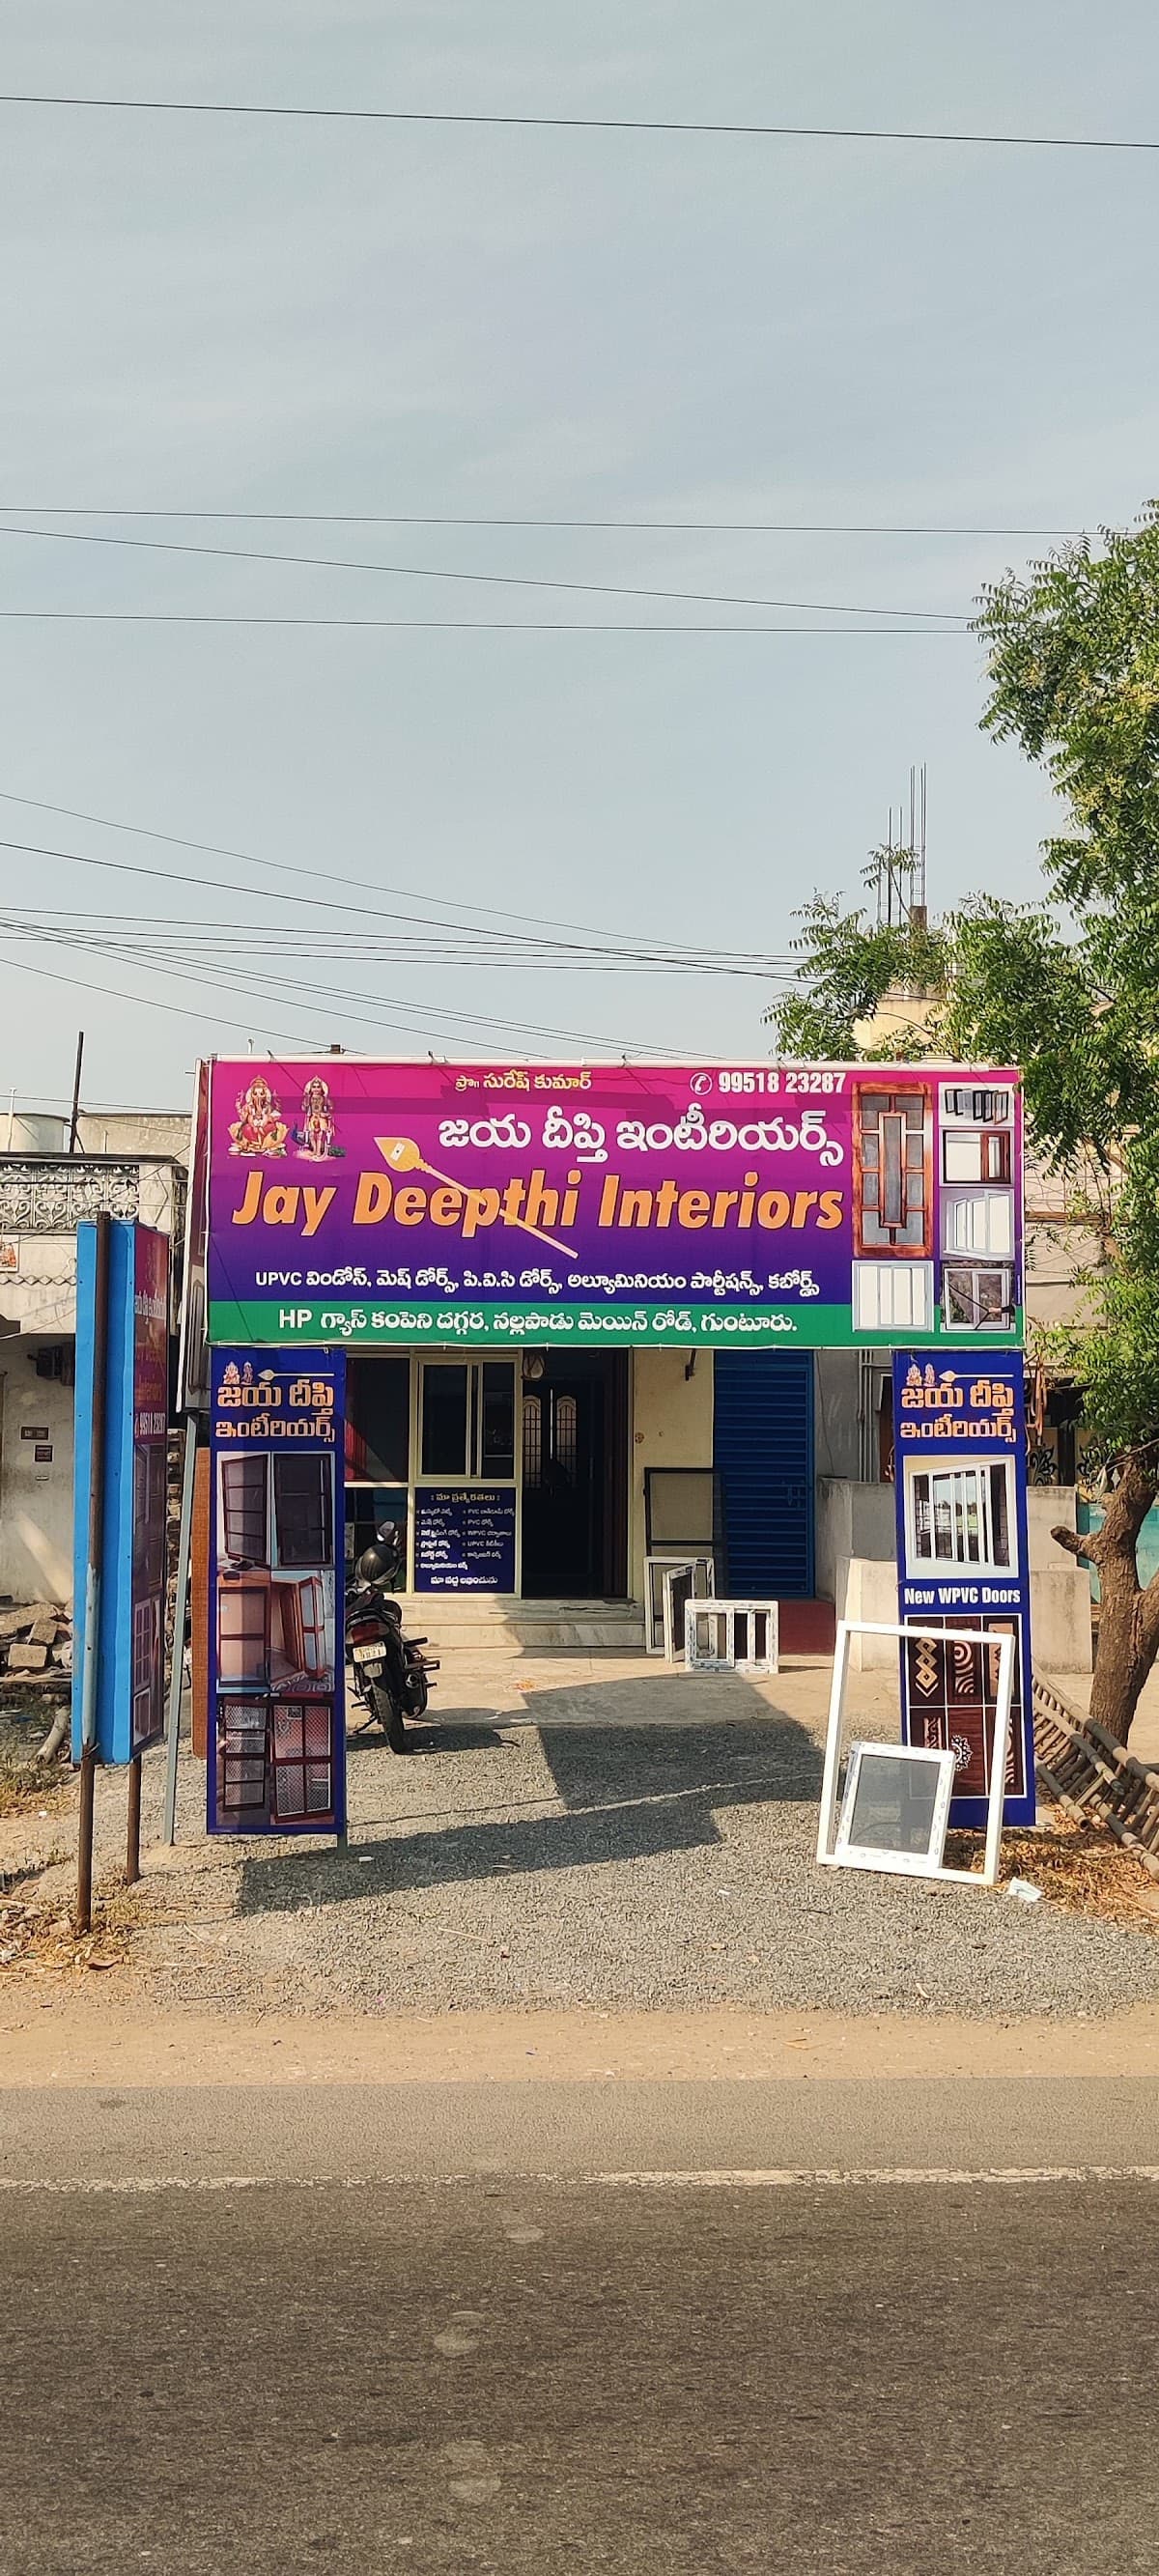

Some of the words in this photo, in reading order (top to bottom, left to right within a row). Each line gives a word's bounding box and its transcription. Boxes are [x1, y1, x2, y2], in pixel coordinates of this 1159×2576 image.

[483, 1069, 530, 1091] సురేష్
[534, 1071, 592, 1090] కుమార్
[719, 1072, 780, 1093] 99518
[785, 1072, 847, 1093] 23287
[438, 1114, 531, 1148] జయ
[542, 1105, 608, 1163] దీప్తి
[616, 1102, 844, 1167] ఇంటీరియర్స్
[232, 1171, 338, 1237] Jay
[353, 1169, 581, 1238] Deepthi
[599, 1172, 844, 1230] Interiors
[255, 1271, 302, 1287] UPVC
[305, 1266, 372, 1288] విండోస్,
[376, 1268, 412, 1289] మెష్
[414, 1266, 460, 1294] డోర్స్,
[519, 1268, 563, 1294] డోర్స్,
[567, 1272, 687, 1295] అల్యూమినియం
[279, 1309, 313, 1329] HP
[321, 1309, 367, 1337] గ్యాస్
[371, 1311, 434, 1329] కంపెని
[437, 1312, 490, 1335] దగ్గర,
[493, 1312, 575, 1336] నల్లపాడు
[652, 1309, 697, 1333] రోడ్,
[700, 1313, 798, 1332] గుంటూరు.
[217, 1381, 282, 1407] జయ
[289, 1378, 334, 1416] దీప్తి
[900, 1382, 964, 1408] జయ
[969, 1379, 1014, 1417] దీప్తి
[215, 1412, 335, 1443] ఇంటీరియర్స్
[899, 1412, 1017, 1443] ఇంటీరియర్స్
[904, 1588, 935, 1605] New
[937, 1587, 979, 1604] WPVC
[981, 1587, 1021, 1603] Doors
